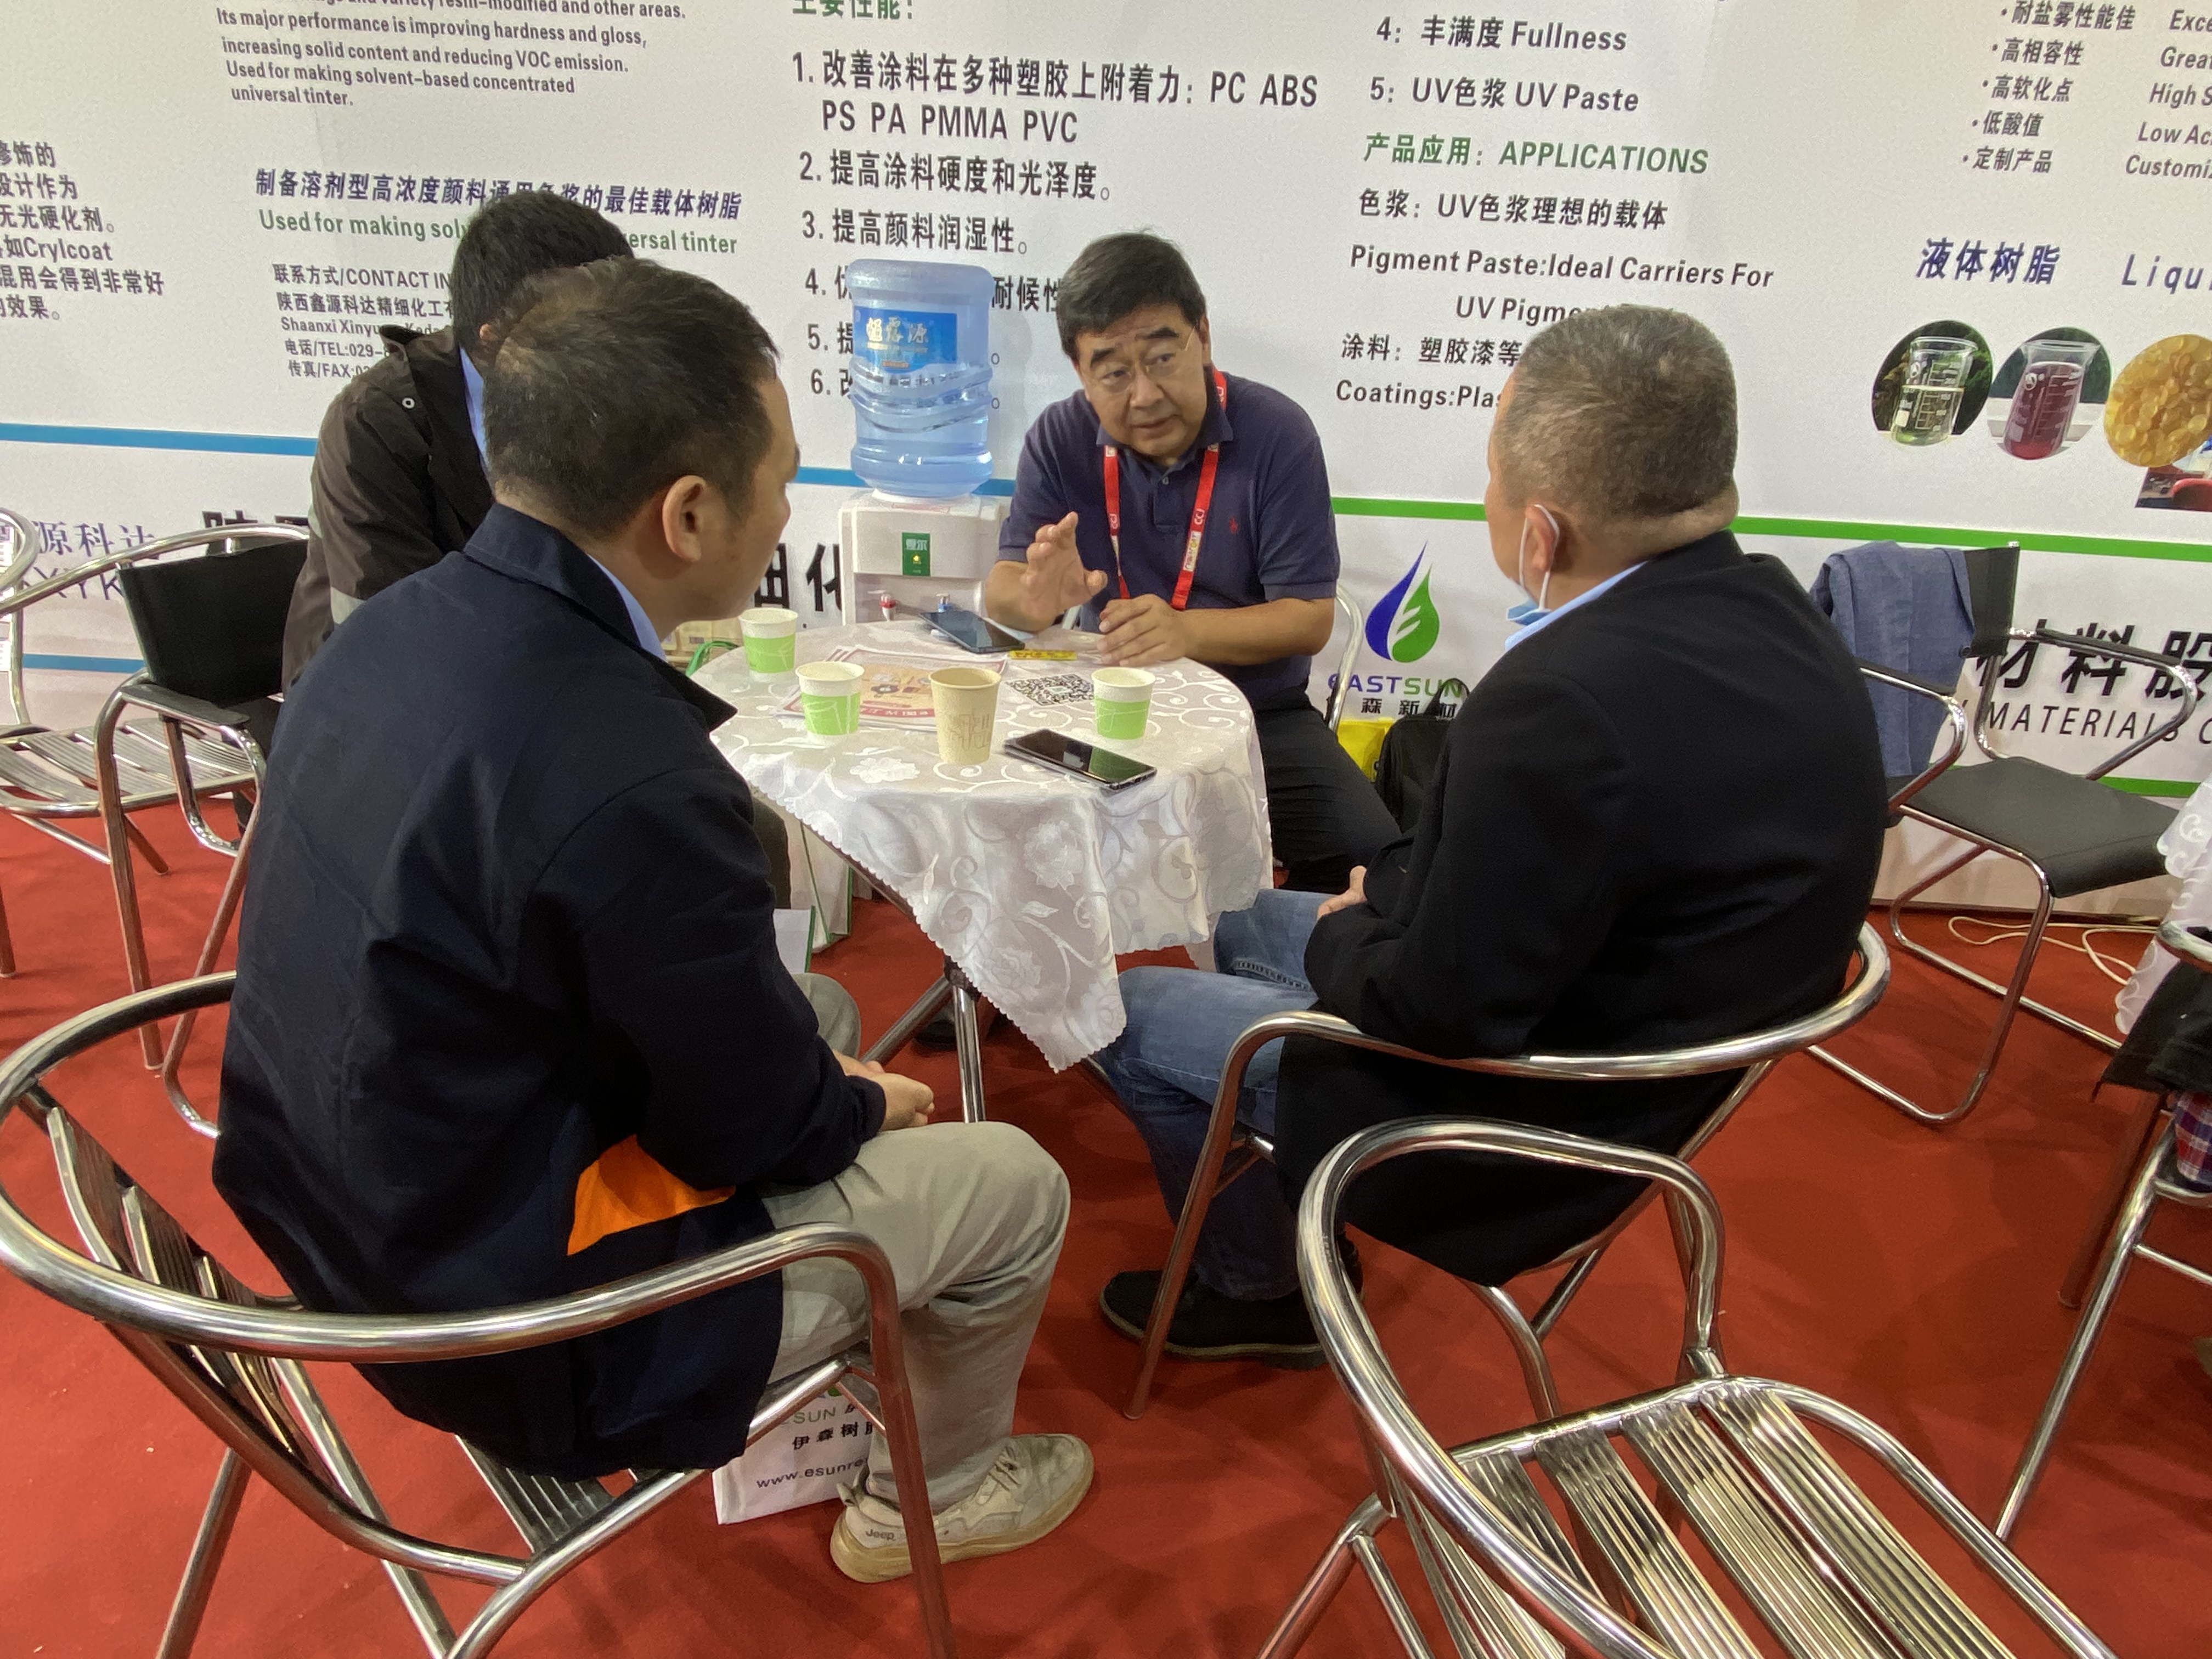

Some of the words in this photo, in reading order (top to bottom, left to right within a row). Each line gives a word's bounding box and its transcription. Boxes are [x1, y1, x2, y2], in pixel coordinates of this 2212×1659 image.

[562, 0, 590, 14] and
[594, 0, 635, 15] other
[639, 3, 686, 18] areas.
[2011, 0, 2136, 30] 耐盐雾性能佳
[216, 8, 237, 25] Its
[240, 9, 284, 30] major
[288, 11, 390, 32] performance
[392, 16, 406, 33] is
[409, 16, 490, 40] improving
[494, 21, 566, 41] hardness
[569, 25, 597, 42] and
[601, 26, 647, 48] gloss,
[1511, 20, 1627, 51] Fullness
[221, 36, 302, 59] increasing
[306, 41, 345, 58] solid
[348, 46, 410, 62] content
[413, 46, 440, 63] and
[444, 47, 512, 70] reducing
[516, 49, 551, 67] VOC
[554, 53, 629, 73] emission.
[2001, 37, 2085, 66] 高相容性
[226, 60, 266, 78] Used
[268, 61, 290, 80] for
[294, 64, 352, 86] making
[473, 76, 575, 94] concentrated
[1210, 70, 1246, 104] PC
[1261, 72, 1318, 107] ABS
[1991, 73, 2074, 103] 高软化点
[231, 84, 301, 103] universal
[303, 87, 354, 106] tinter.
[1515, 82, 1556, 108] UV
[1563, 83, 1640, 111] Paste
[2149, 82, 2197, 109] High
[822, 99, 855, 131] PS
[871, 102, 906, 134] PA
[921, 104, 1007, 140] PMMA
[1023, 110, 1078, 143] PVC
[1982, 110, 2044, 138] 低酸值
[2137, 121, 2182, 143] Low
[1972, 145, 2053, 173] 定制产品
[2125, 154, 2212, 179] Customi
[258, 209, 311, 232] Used
[315, 212, 343, 233] for
[349, 215, 425, 242] making
[625, 229, 676, 251] ersal
[681, 231, 737, 255] tinter
[1350, 244, 1460, 274] Pigment
[1620, 257, 1725, 285] Carriers
[1731, 262, 1774, 287] For
[1916, 237, 2061, 285] 液体树脂
[1456, 295, 1497, 319] UV
[280, 317, 337, 333] Shaanxi
